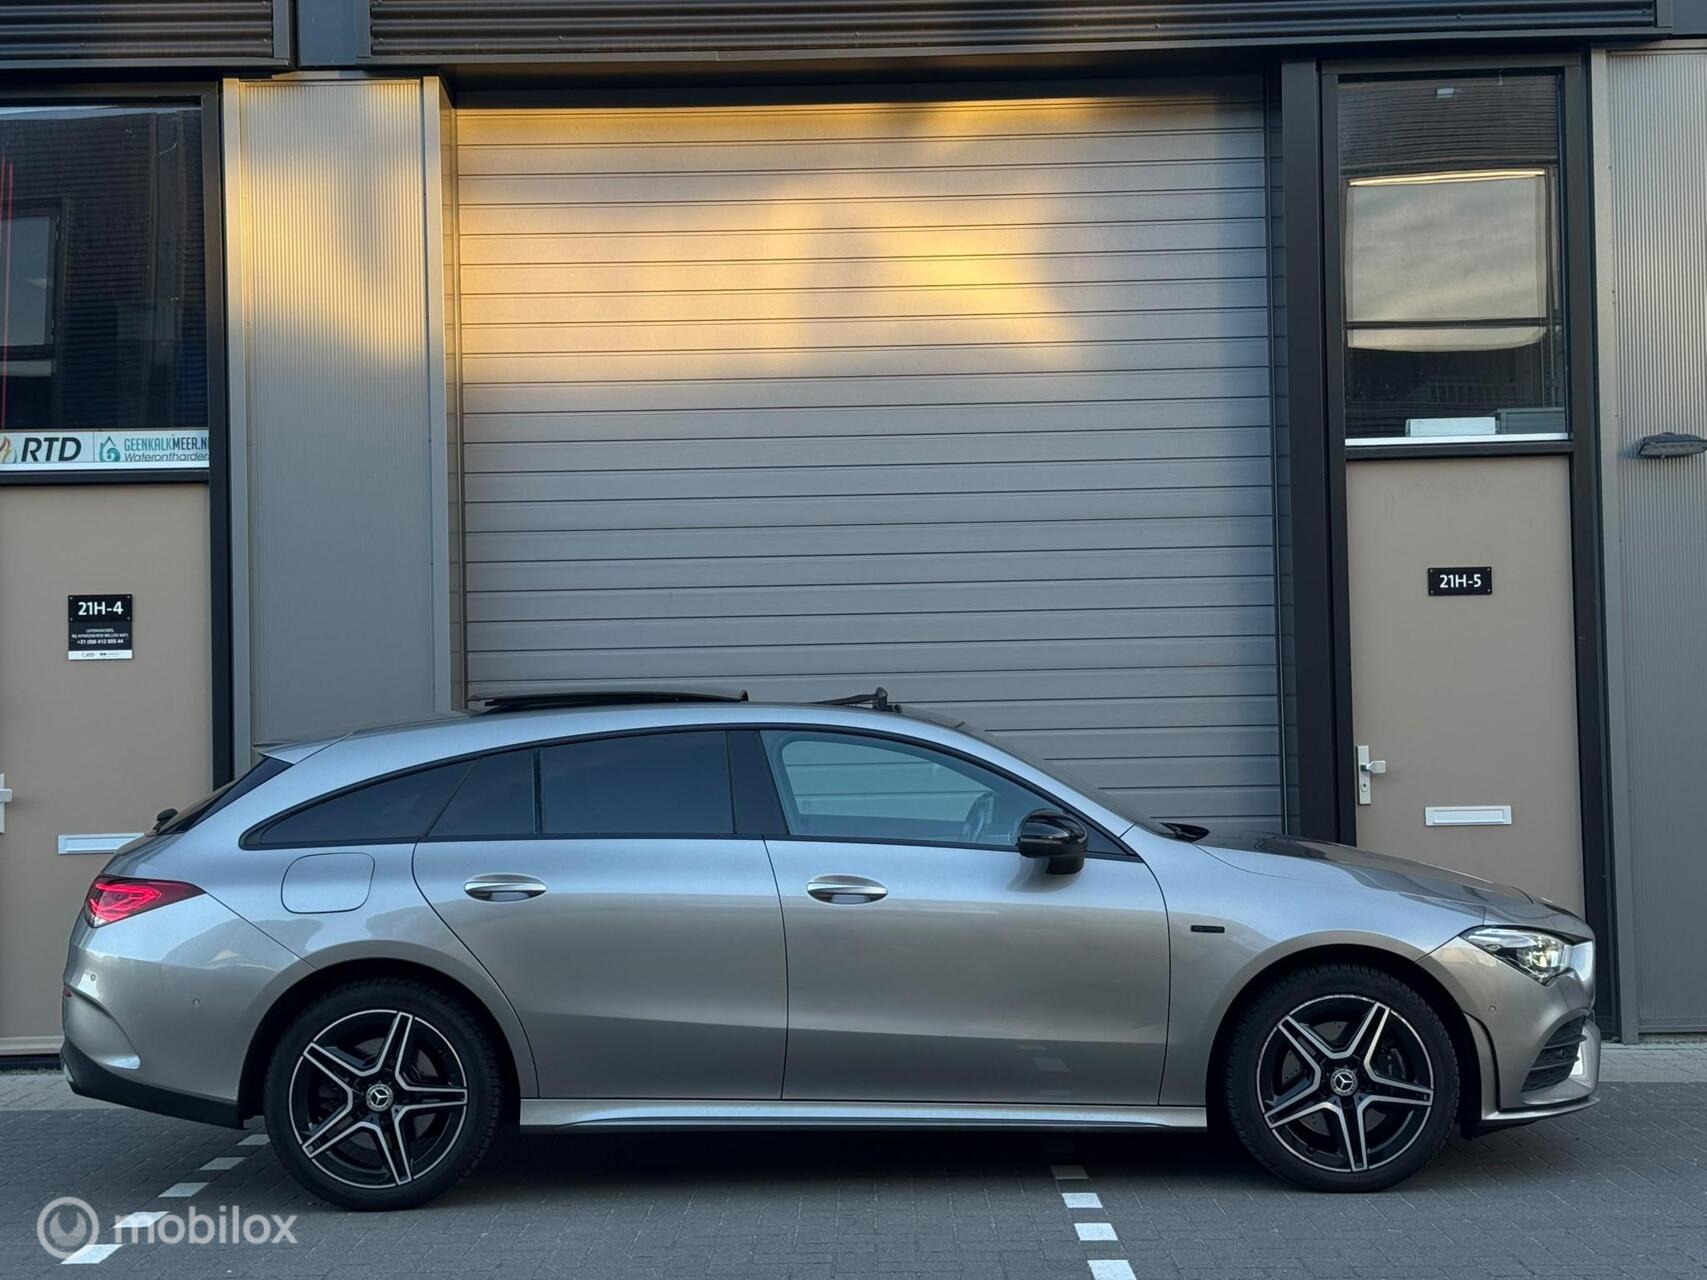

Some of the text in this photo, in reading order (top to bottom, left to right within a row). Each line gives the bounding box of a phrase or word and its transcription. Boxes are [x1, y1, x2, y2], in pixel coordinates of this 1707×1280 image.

[21, 437, 81, 462] RTD
[1440, 574, 1482, 588] 21H-5
[78, 601, 124, 616] 21H-4
